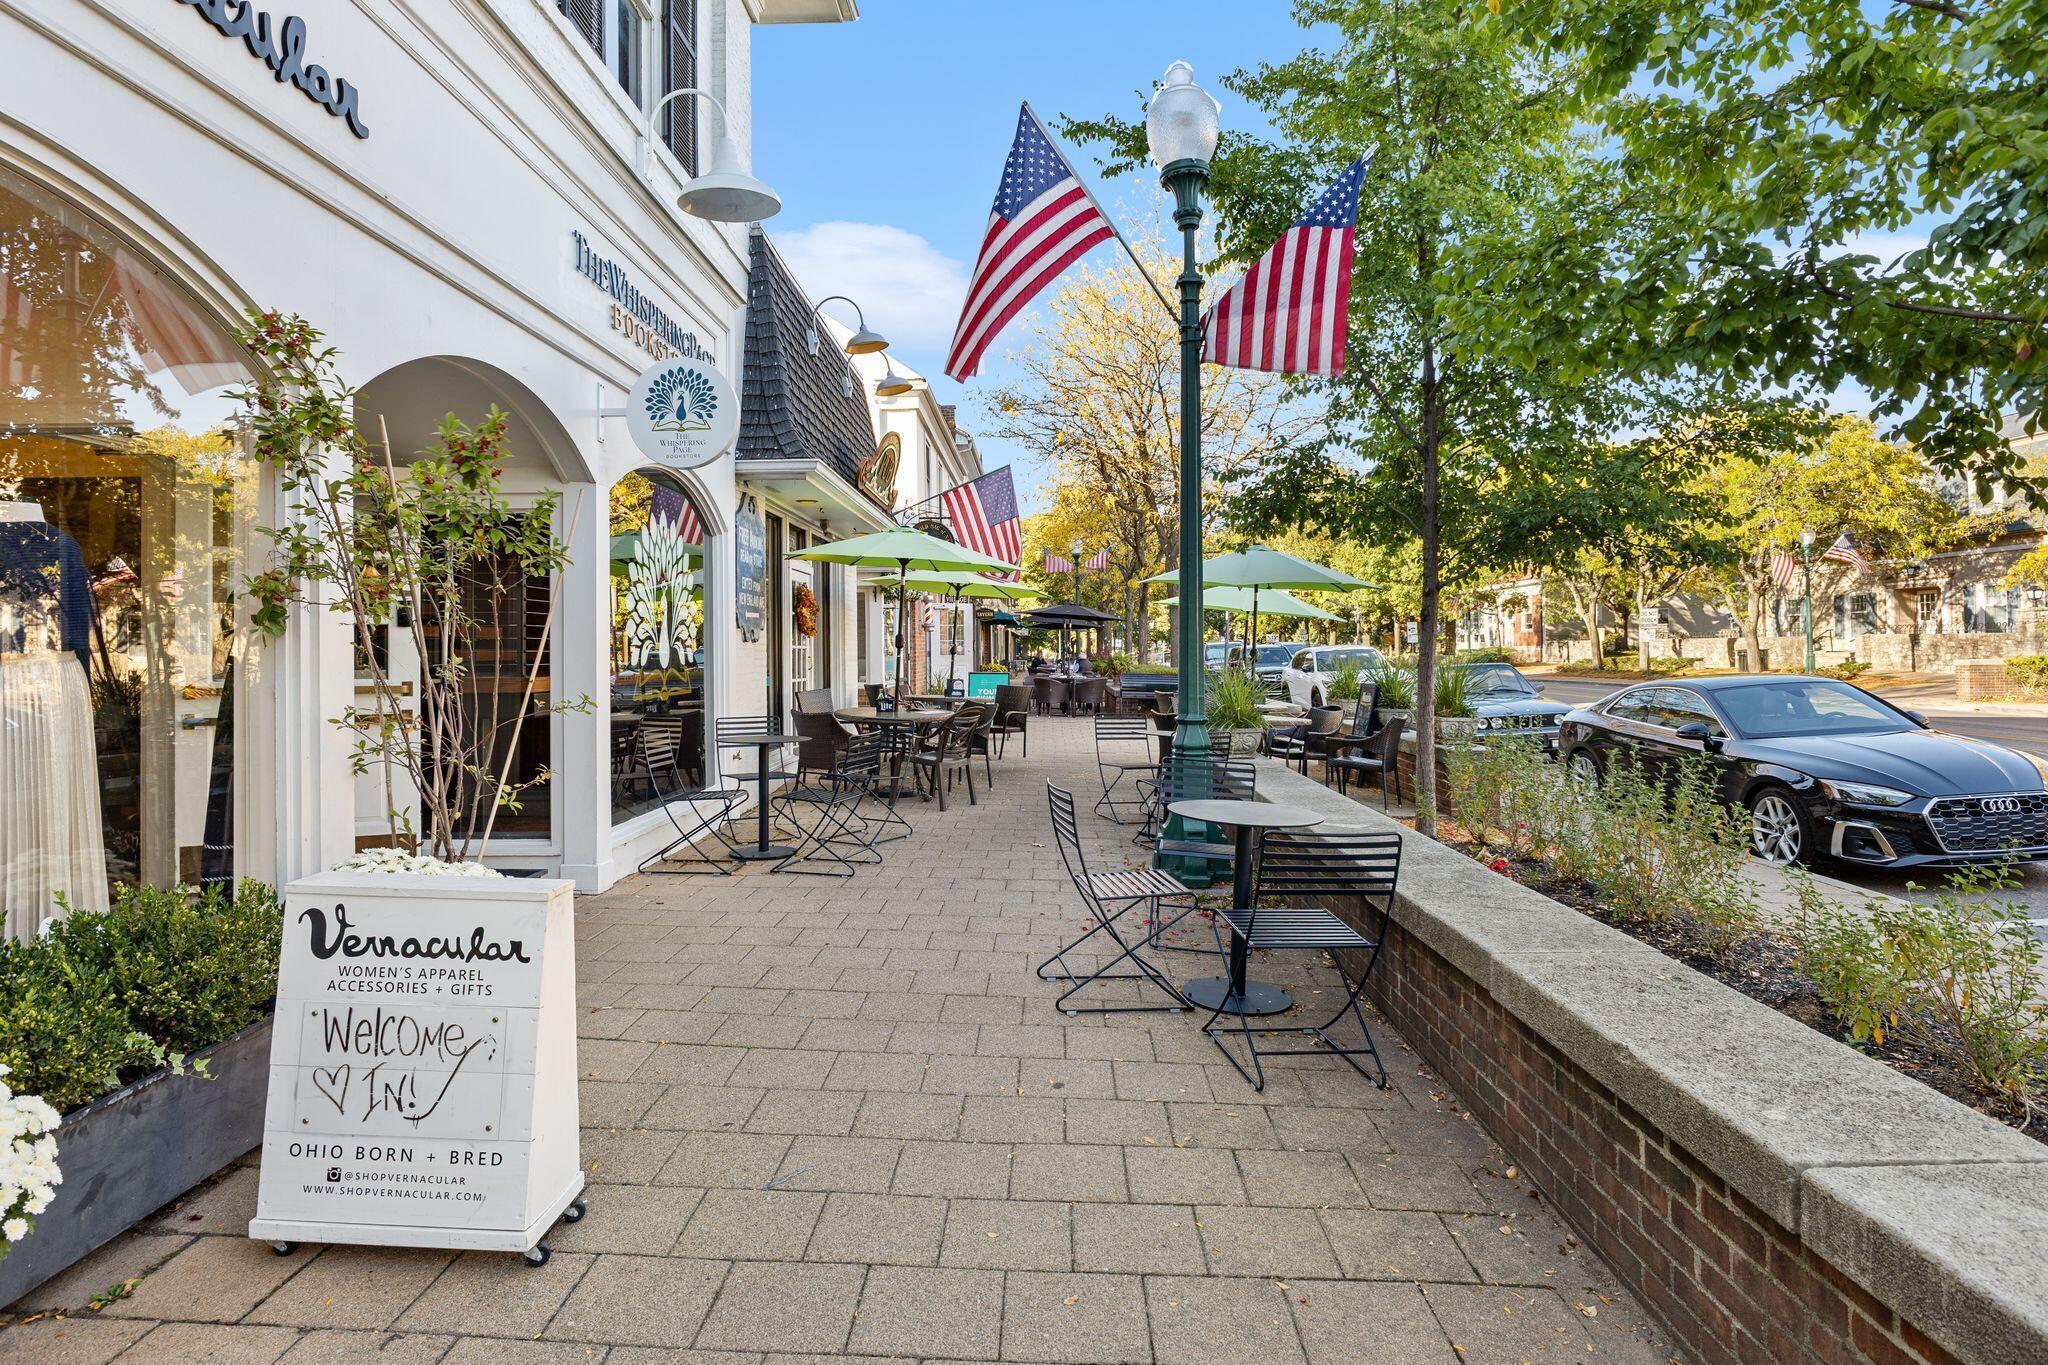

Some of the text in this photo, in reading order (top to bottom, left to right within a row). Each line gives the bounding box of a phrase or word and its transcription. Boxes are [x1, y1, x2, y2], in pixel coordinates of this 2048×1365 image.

[173, 0, 370, 140] cular
[609, 303, 679, 361] BOOKST
[659, 439, 706, 447] WHISPERING
[674, 432, 688, 440] THE
[880, 702, 893, 711] Lite
[298, 903, 531, 964] Vernacular
[338, 965, 485, 981] WOMEN'S APPAREL
[326, 980, 428, 994] ACCESSORIES
[450, 984, 493, 996] GIFTS
[289, 1143, 344, 1159] OHIO
[355, 1146, 413, 1163] BORN
[449, 1150, 504, 1166] BRED
[344, 1171, 467, 1185] @SHOPVERNACULAR
[302, 1185, 483, 1201] WWW.SHOPVERNACULAR.COM
